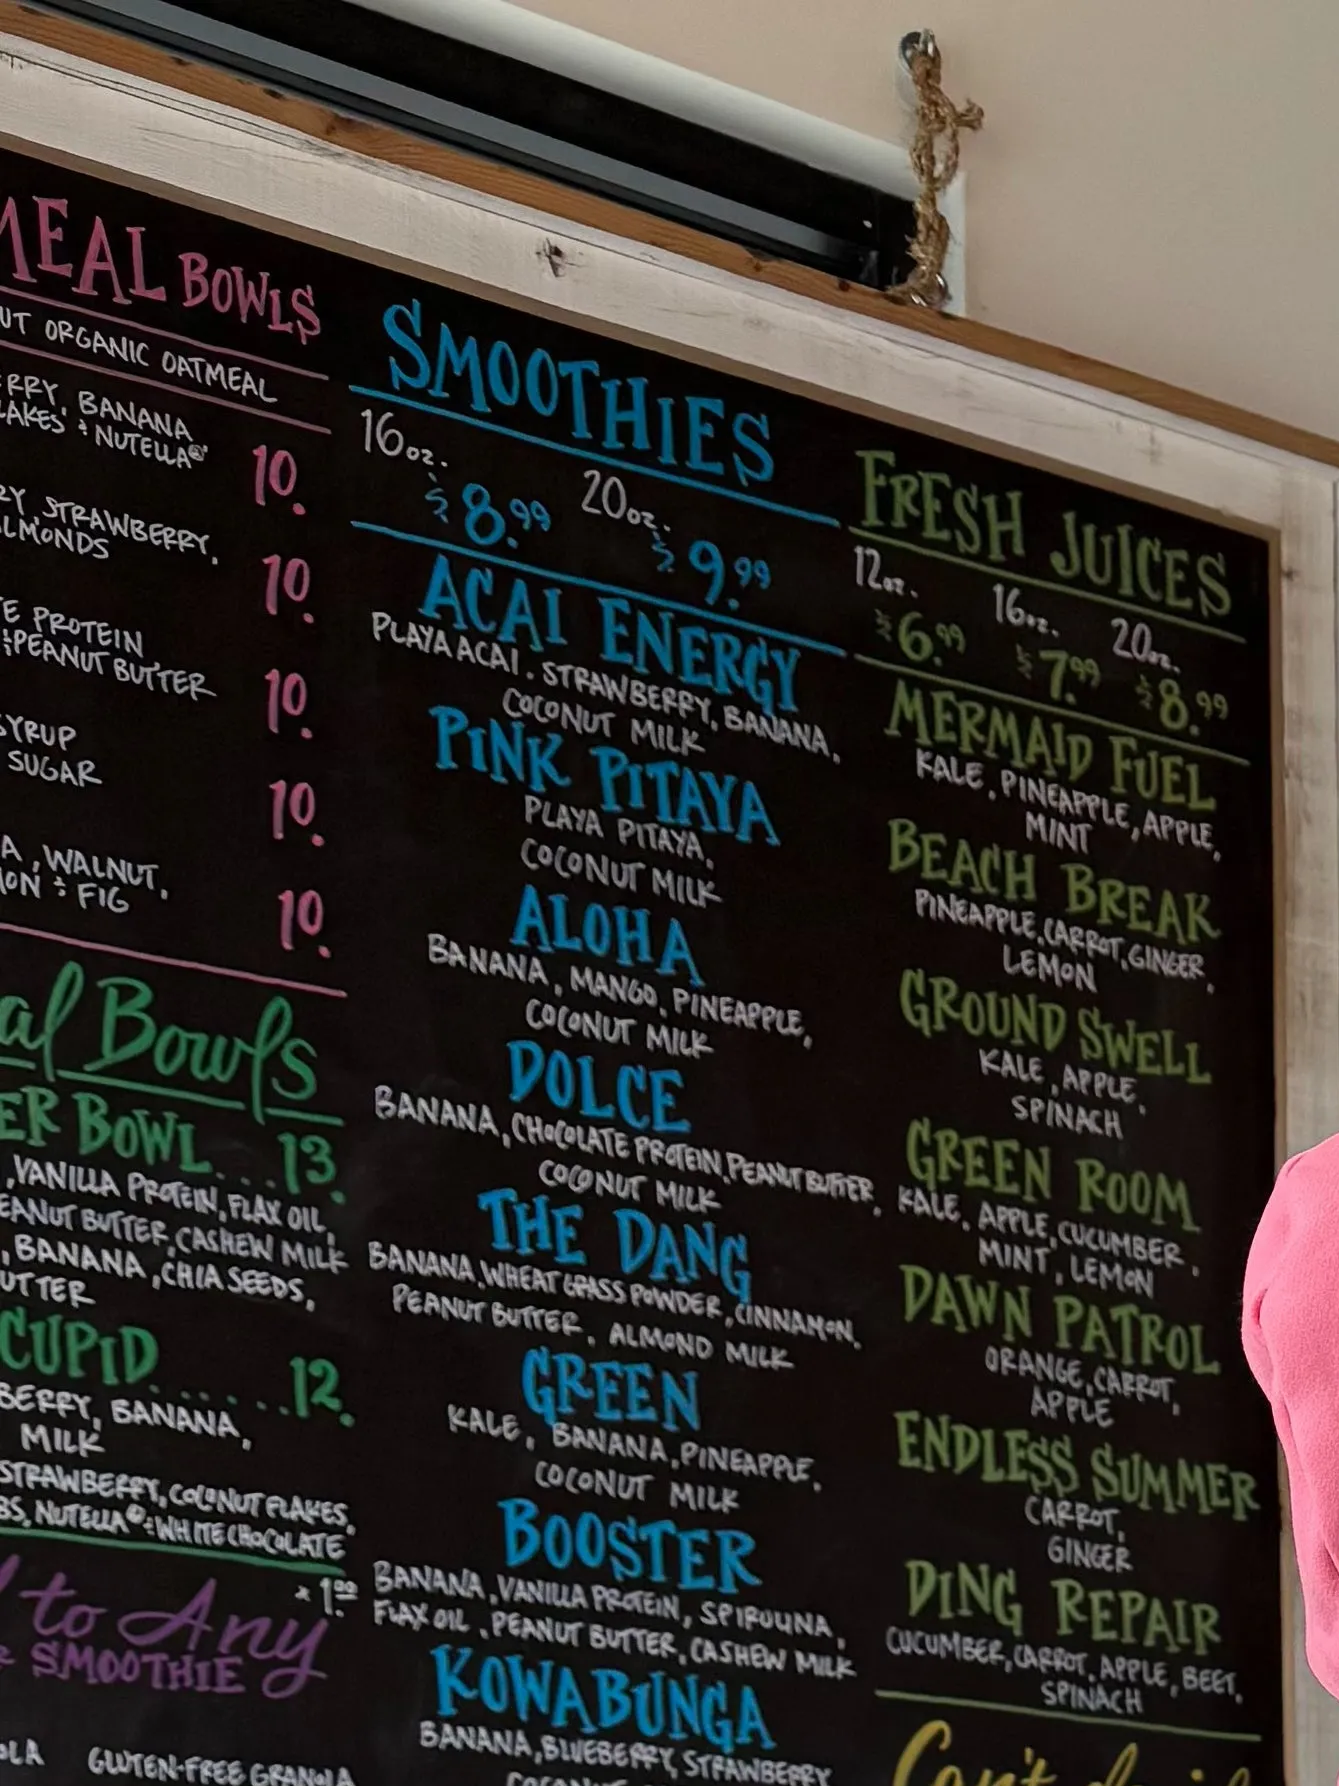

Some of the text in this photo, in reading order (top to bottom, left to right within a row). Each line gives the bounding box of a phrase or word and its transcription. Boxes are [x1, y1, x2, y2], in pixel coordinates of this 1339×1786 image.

[177, 251, 321, 346] BOWLS
[44, 319, 278, 403] ORGANIC OATMEAL
[379, 294, 778, 492] SMOOTHIES
[851, 450, 1231, 622] FRESH JUICES
[33, 606, 144, 662] PROTEIN
[418, 553, 803, 716] ACAI ENERGY
[7, 749, 103, 787] SUGAR
[502, 687, 706, 756] COCONUT MILK
[884, 674, 1217, 811] MERMAID FUEL
[428, 701, 781, 850] PINK PITAYA
[509, 879, 709, 991] ALOHA
[888, 818, 1220, 946] BEACH BREAK
[84, 976, 318, 1125] Bowls
[900, 968, 1212, 1084] GROUND SWELL
[72, 1092, 212, 1173] BOWL
[506, 1039, 691, 1137] DOLCE
[1011, 1095, 1123, 1139] SPINACH
[906, 1117, 1201, 1233] GREEN ROOM
[477, 1187, 754, 1304] THE DANG
[0, 1306, 158, 1386] CUPID
[899, 1264, 1220, 1375] DAWN PATROL
[521, 1346, 699, 1436] GREEN
[893, 1410, 1260, 1521] ENDLESS SUMMER
[496, 1498, 762, 1601] BOOSTER
[1047, 1535, 1133, 1573] GINGER
[19, 1572, 333, 1700] to Any
[905, 1559, 1221, 1656] DING REPAIR
[30, 1640, 246, 1694] SMOOTHIE
[430, 1640, 780, 1759] KOWABUNGA
[87, 1746, 246, 1786] GLUTEN-FREE
